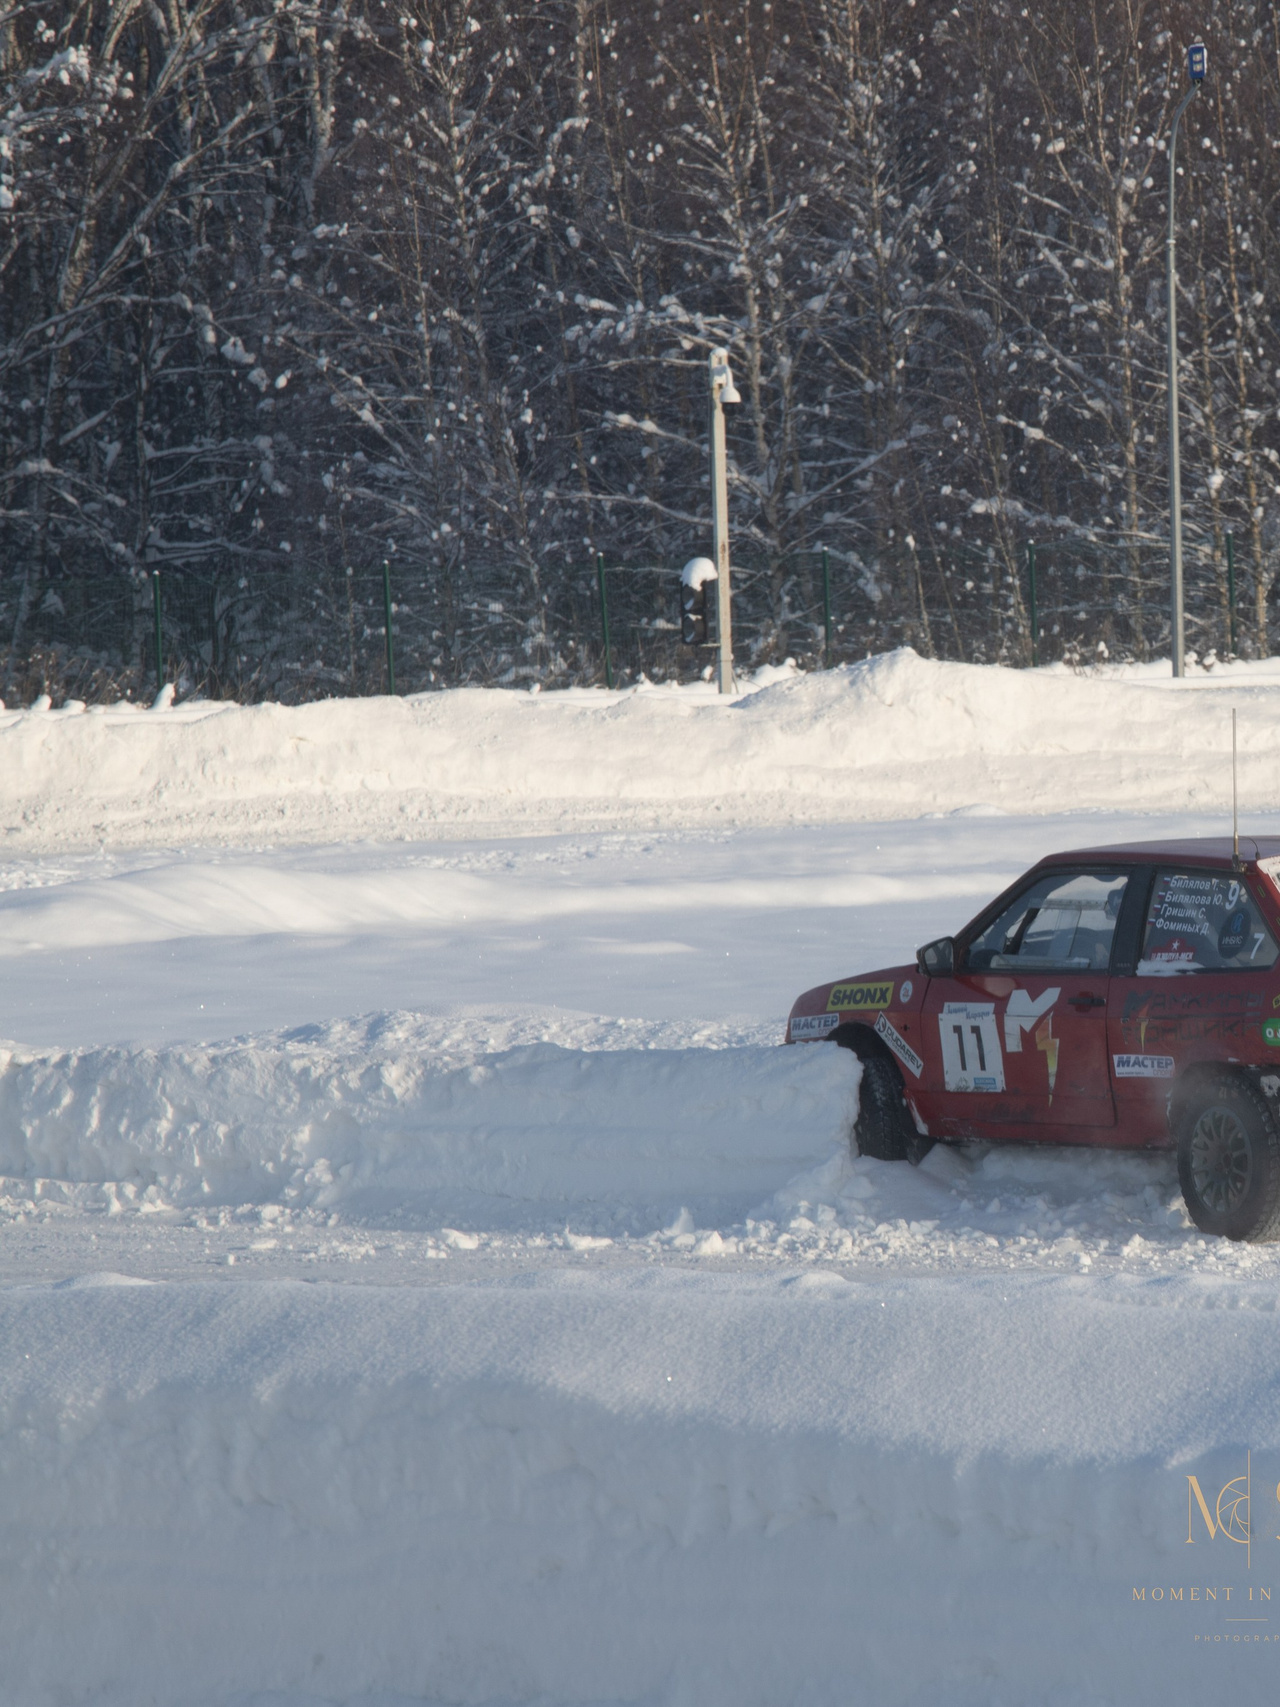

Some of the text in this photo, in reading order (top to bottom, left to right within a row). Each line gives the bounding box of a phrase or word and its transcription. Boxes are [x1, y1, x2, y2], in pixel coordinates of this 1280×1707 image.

[1170, 876, 1211, 890] Билялов
[1165, 891, 1212, 905] Билялова
[1225, 883, 1240, 910] 9
[1161, 904, 1197, 918] Гришин
[1155, 918, 1200, 933] Фоминых
[1250, 932, 1265, 960] 7
[831, 986, 890, 1007] SHONX
[792, 1014, 839, 1032] МАСТЕР
[886, 1025, 922, 1069] DUDAREV
[952, 1025, 986, 1071] 11
[1116, 1055, 1173, 1069] МАСТЕР
